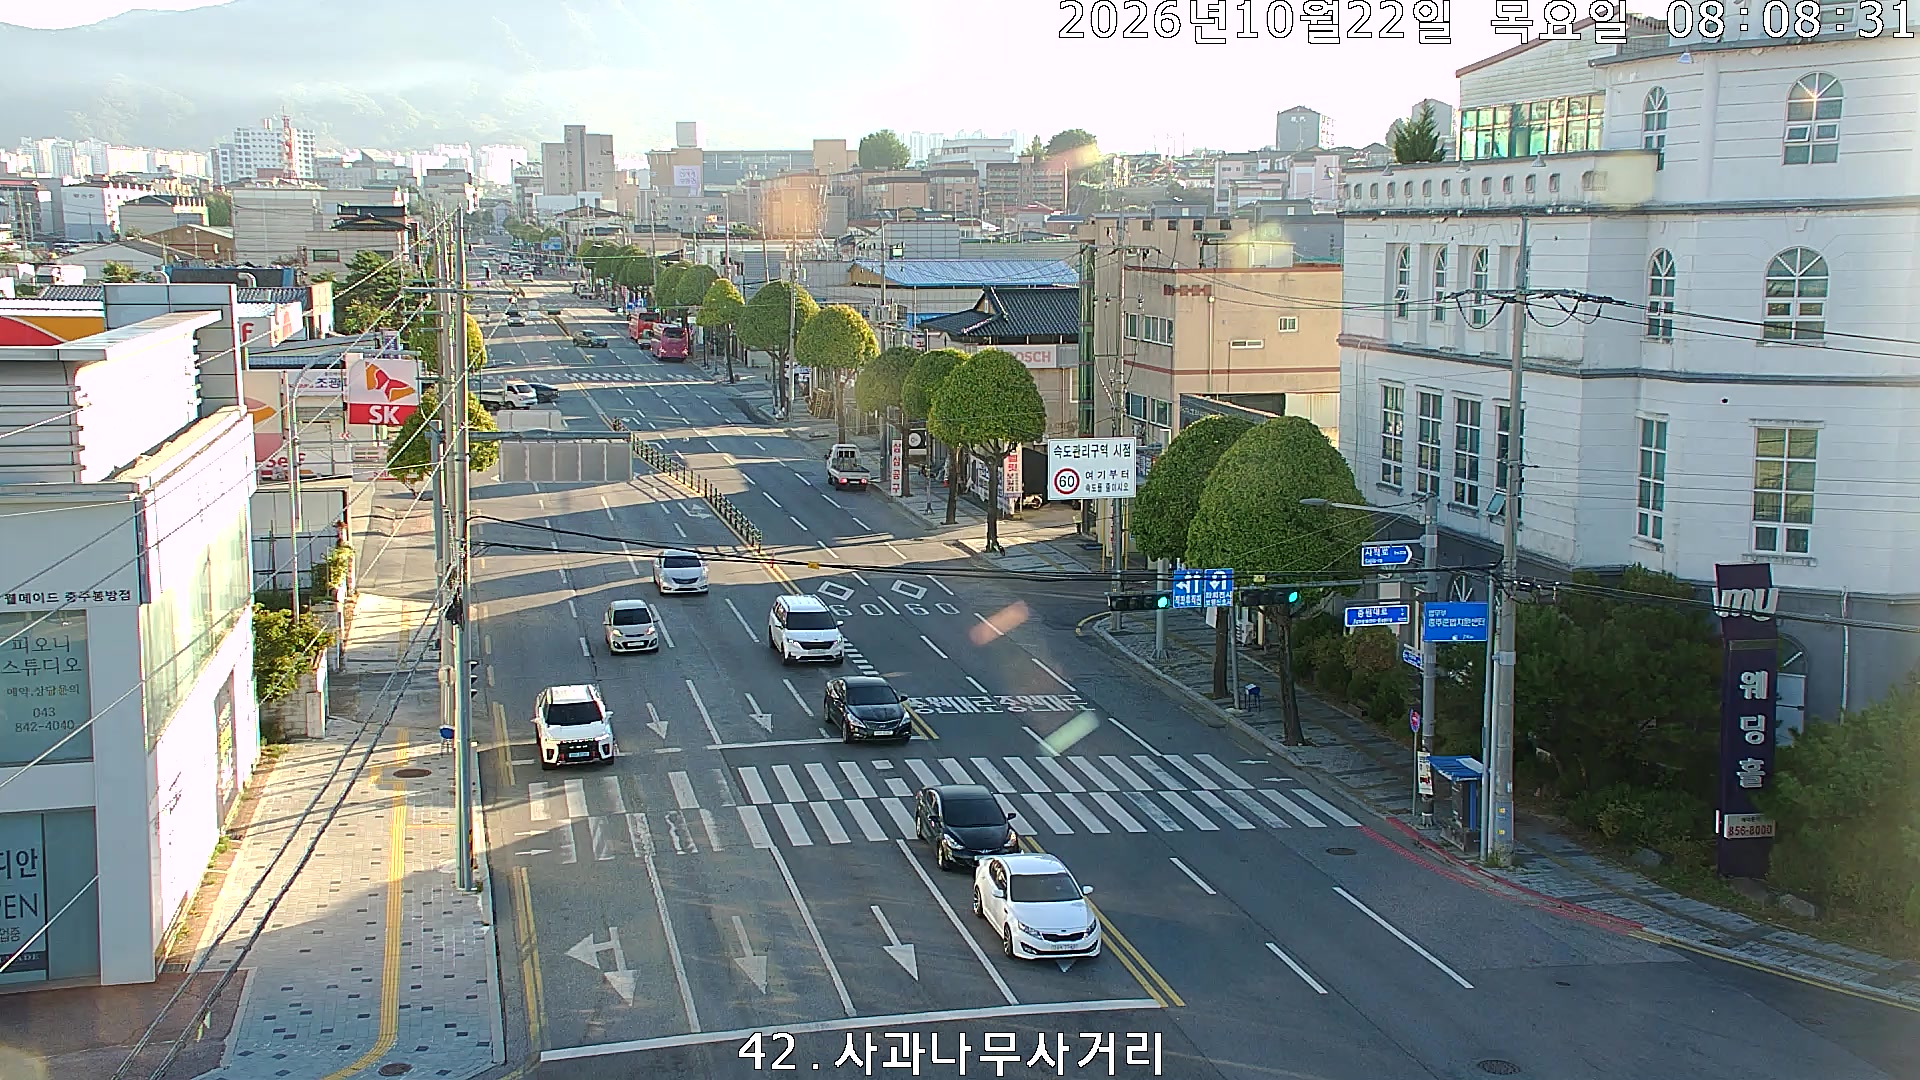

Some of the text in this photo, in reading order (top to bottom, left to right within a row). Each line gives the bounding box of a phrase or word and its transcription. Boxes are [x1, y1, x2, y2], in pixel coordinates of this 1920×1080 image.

[1015, 350, 1051, 363] OSCH
[368, 405, 400, 425] SK
[1053, 443, 1131, 459] 속도관리구역 시점
[1059, 475, 1075, 488] 60
[4, 589, 131, 605] 웰메이드 충주봉방점
[11, 635, 71, 654] 피오니
[1, 657, 82, 676] 스튜디오
[32, 707, 56, 718] 043
[15, 720, 75, 733] 842-4040
[1737, 670, 1768, 789] 웨딩홀
[1728, 825, 1772, 836] 856-8000
